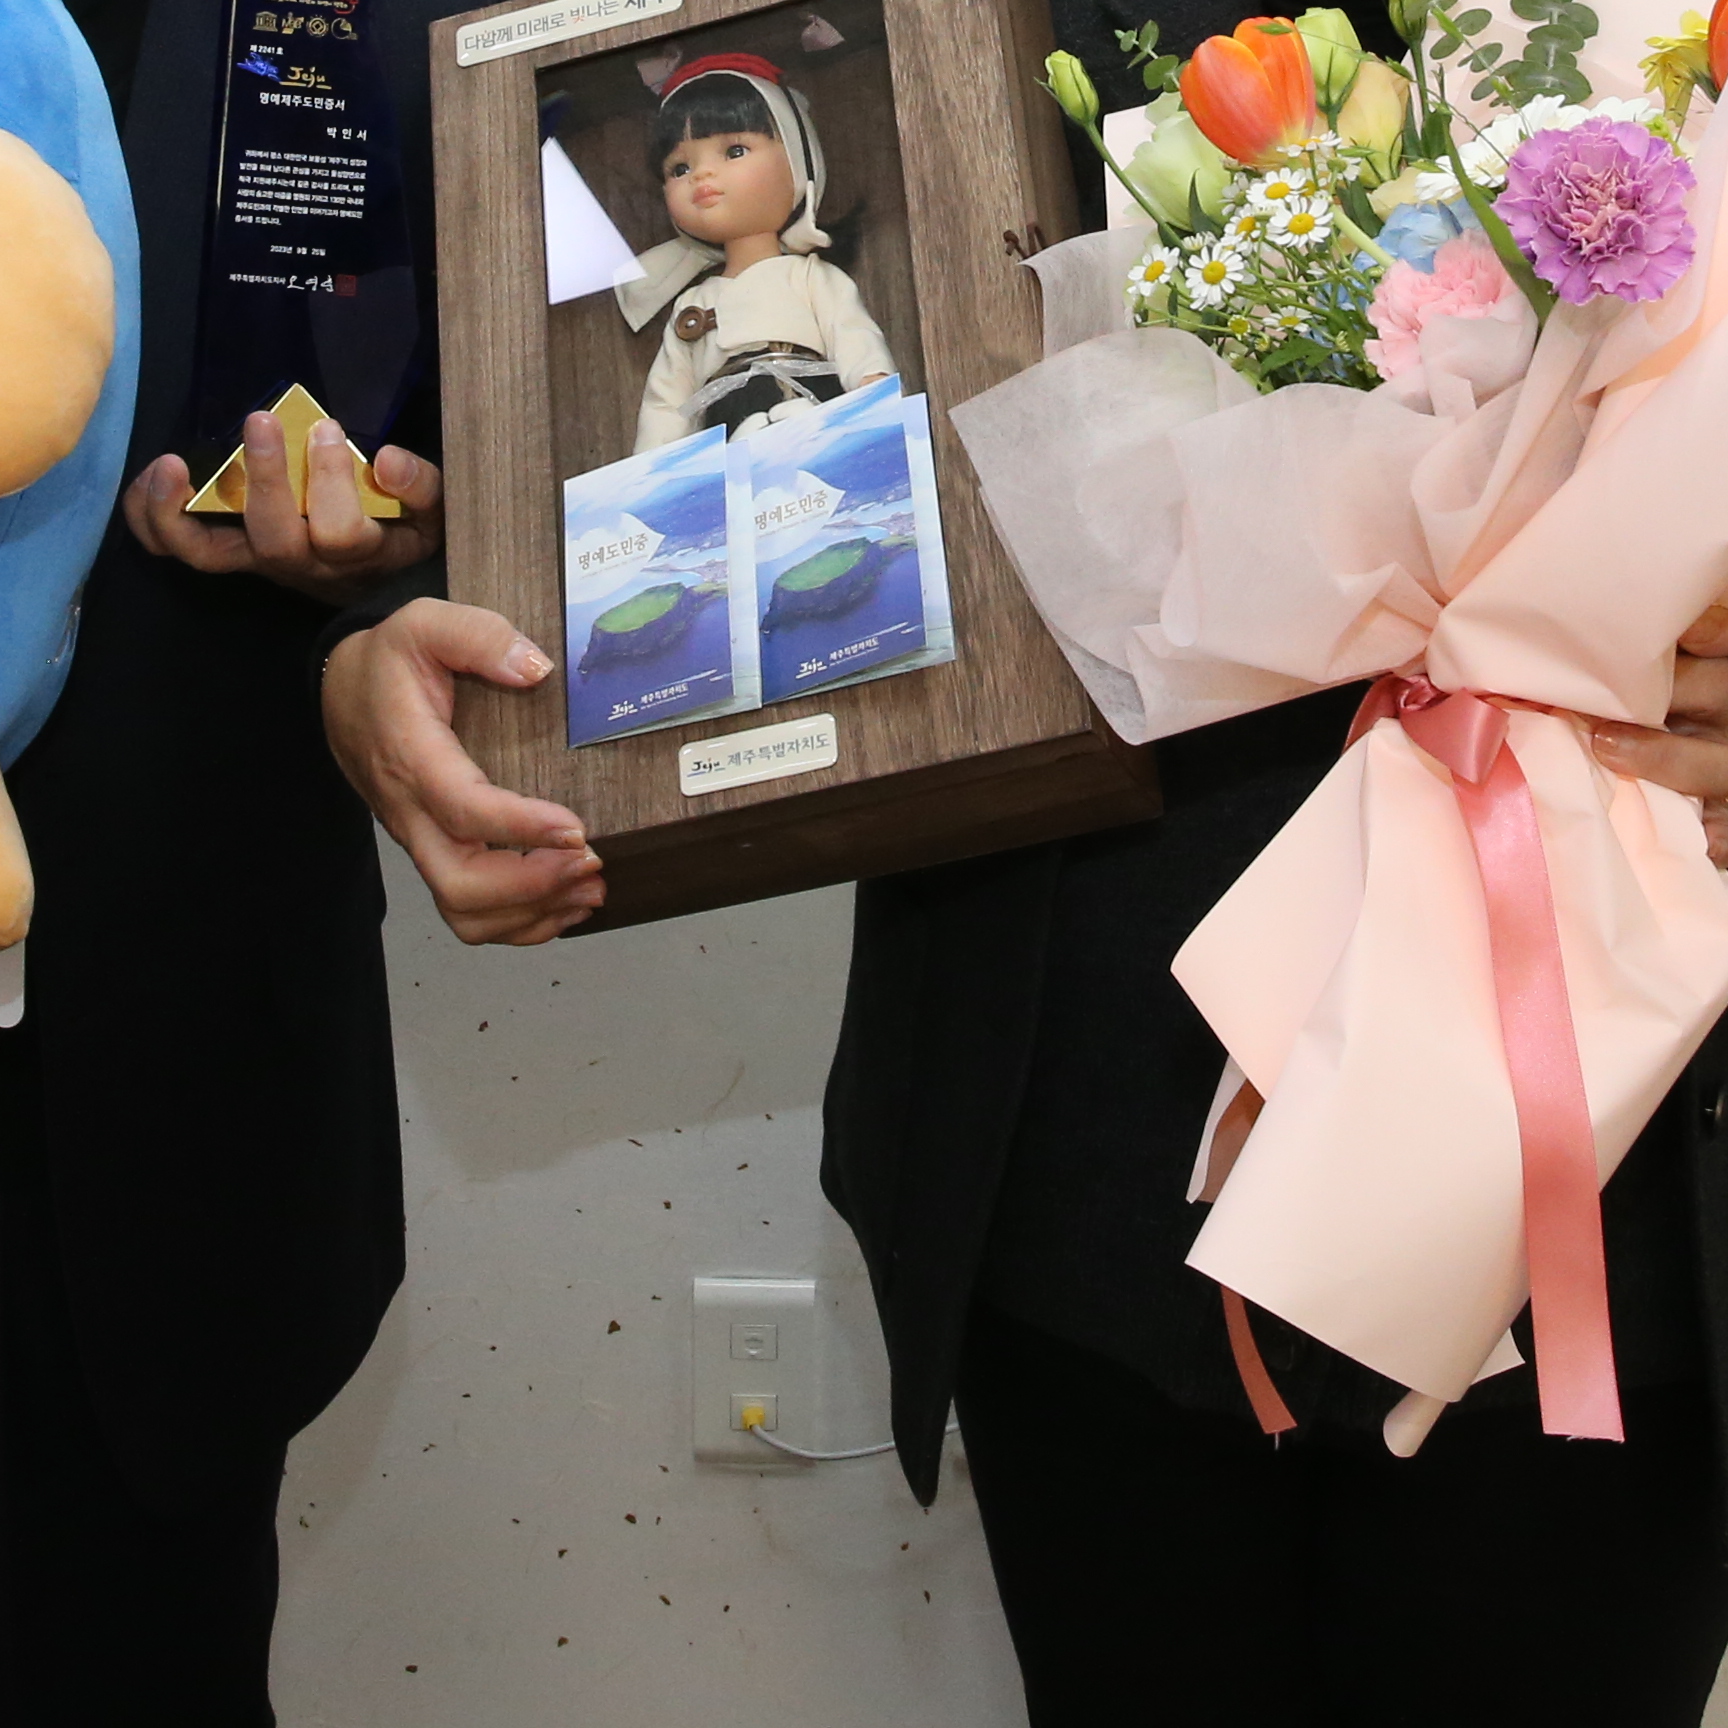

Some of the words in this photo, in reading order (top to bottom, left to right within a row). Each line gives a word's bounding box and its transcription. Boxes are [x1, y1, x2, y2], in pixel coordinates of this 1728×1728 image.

[517, 13, 567, 37] 미래로
[259, 92, 345, 111] 명예제주도민증서
[753, 490, 829, 531] 명예도민증
[577, 533, 648, 570] 명예도민증
[727, 733, 831, 768] 제주특별자치도
